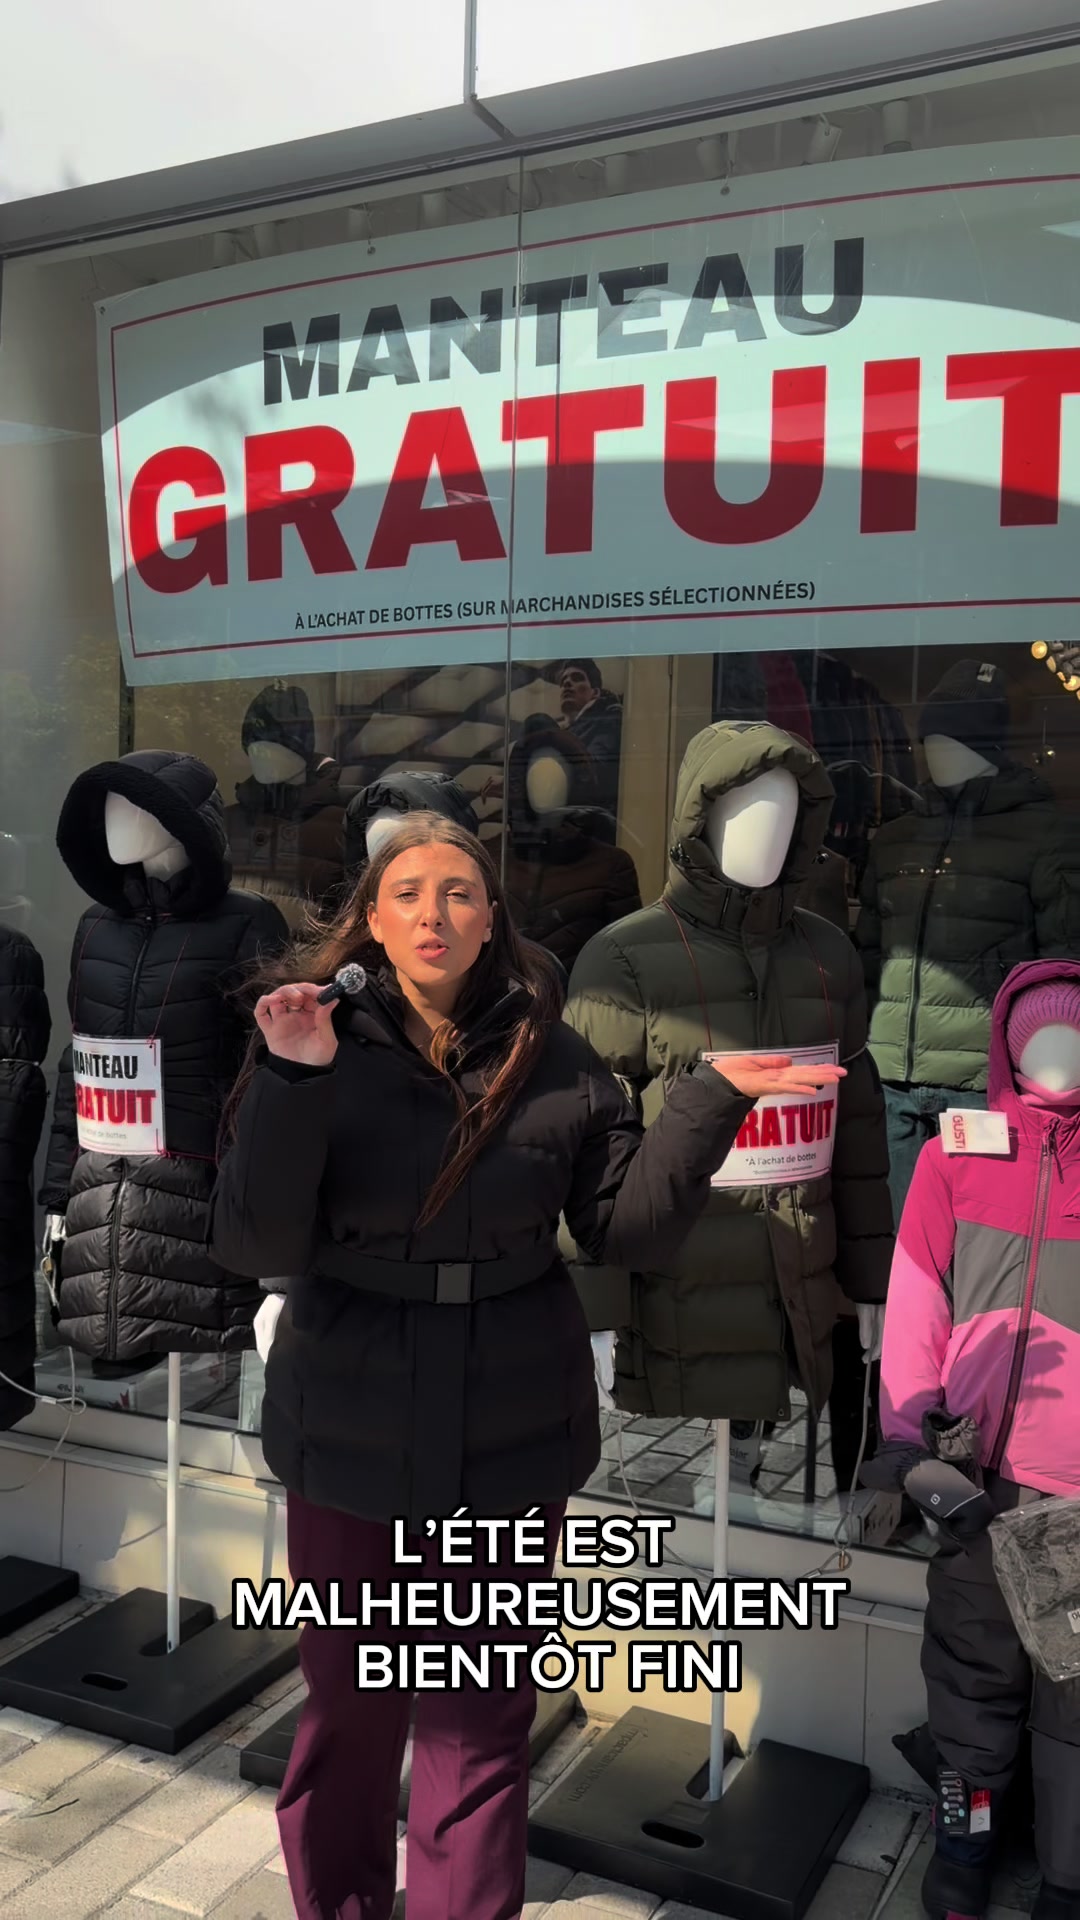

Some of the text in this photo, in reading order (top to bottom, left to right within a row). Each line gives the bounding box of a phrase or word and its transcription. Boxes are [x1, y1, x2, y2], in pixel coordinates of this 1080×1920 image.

[263, 237, 865, 406] MANTEAU
[128, 347, 1080, 594] GRATUIT
[294, 579, 816, 630] À L’ACHAT DE BOTTES (SUR MARCHANDISES SÉLECTIONNÉES)
[73, 1048, 138, 1079] MANTEAU
[76, 1082, 156, 1124] RATUIT
[732, 1099, 835, 1149] RATUIT
[952, 1114, 966, 1149] GUSTI
[786, 1155, 796, 1163] de
